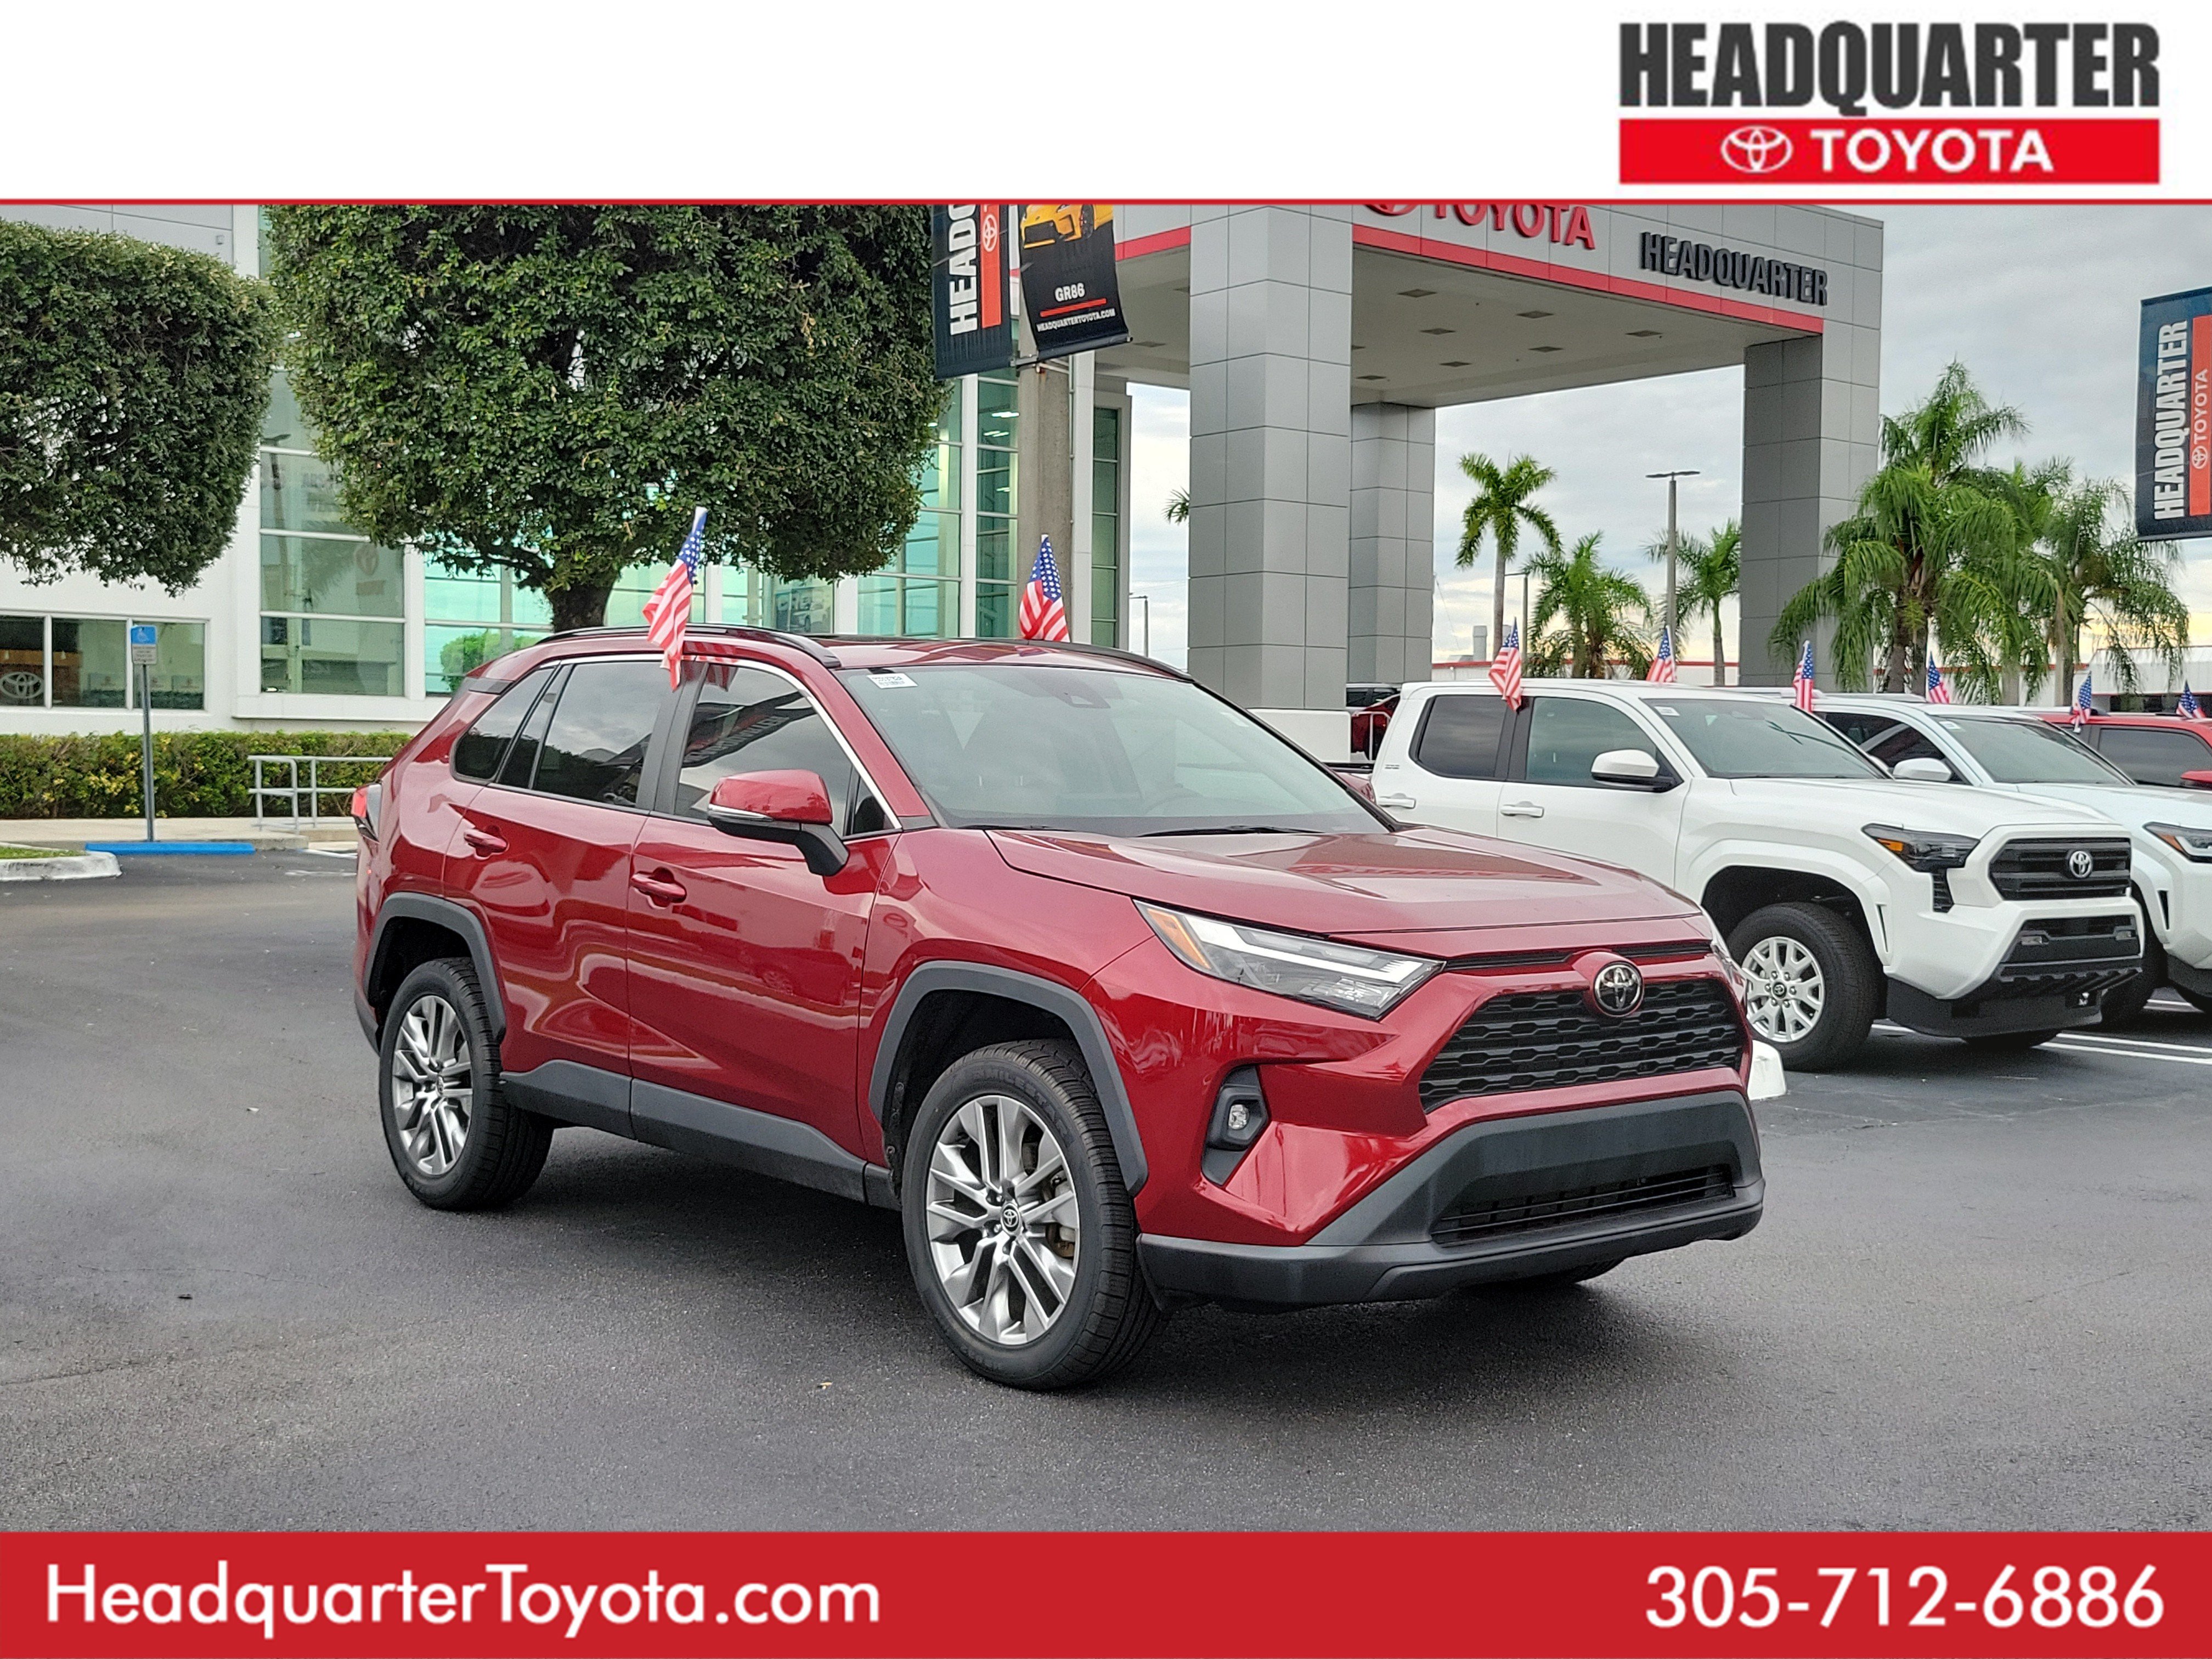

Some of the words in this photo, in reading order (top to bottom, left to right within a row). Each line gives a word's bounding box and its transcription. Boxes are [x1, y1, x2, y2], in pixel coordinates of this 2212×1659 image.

[1054, 283, 1086, 302] GR86
[1639, 232, 1828, 306] HEADQUARTER
[1036, 308, 1116, 332] HEADQUARTERTOYOTA.COM
[2154, 320, 2190, 520] HEADQUARTER
[2193, 369, 2208, 445] TOYOTA
